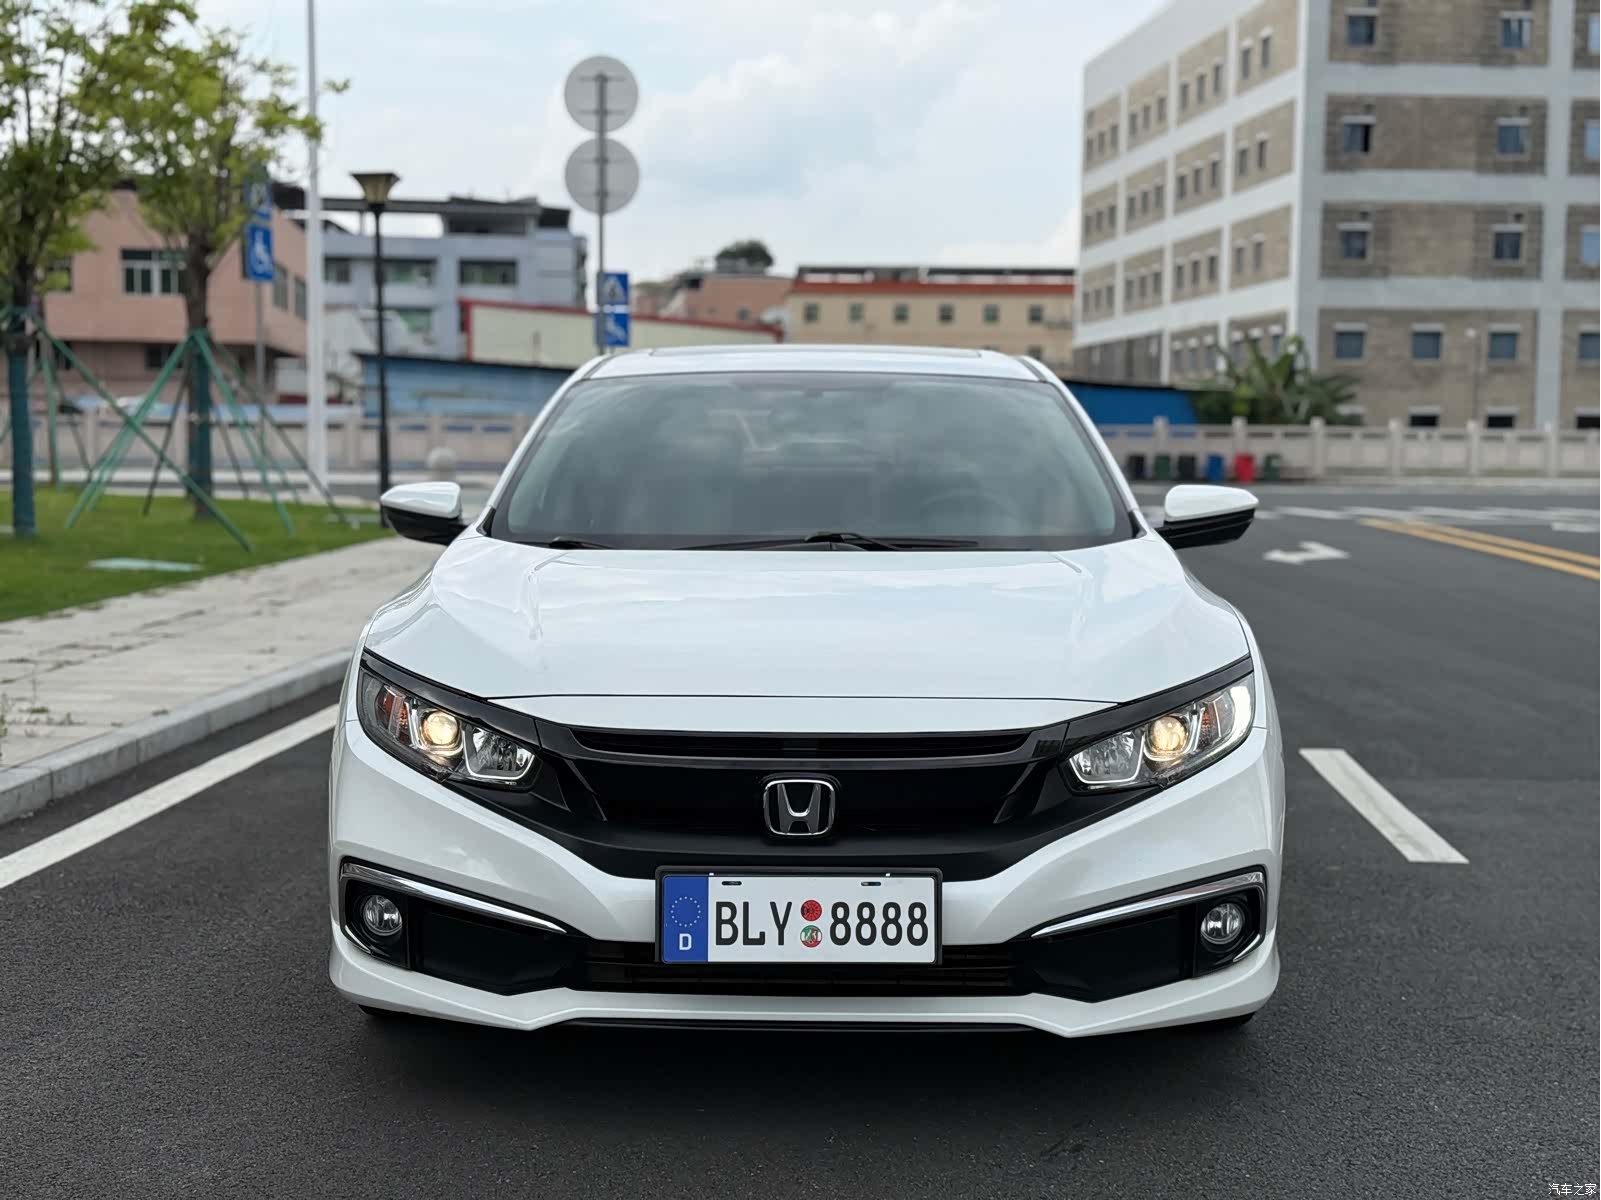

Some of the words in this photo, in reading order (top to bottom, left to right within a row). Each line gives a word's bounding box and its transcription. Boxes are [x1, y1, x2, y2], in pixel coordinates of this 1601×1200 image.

[777, 783, 821, 833] H
[679, 933, 692, 951] D
[715, 901, 793, 946] BLY
[829, 901, 929, 947] 8888
